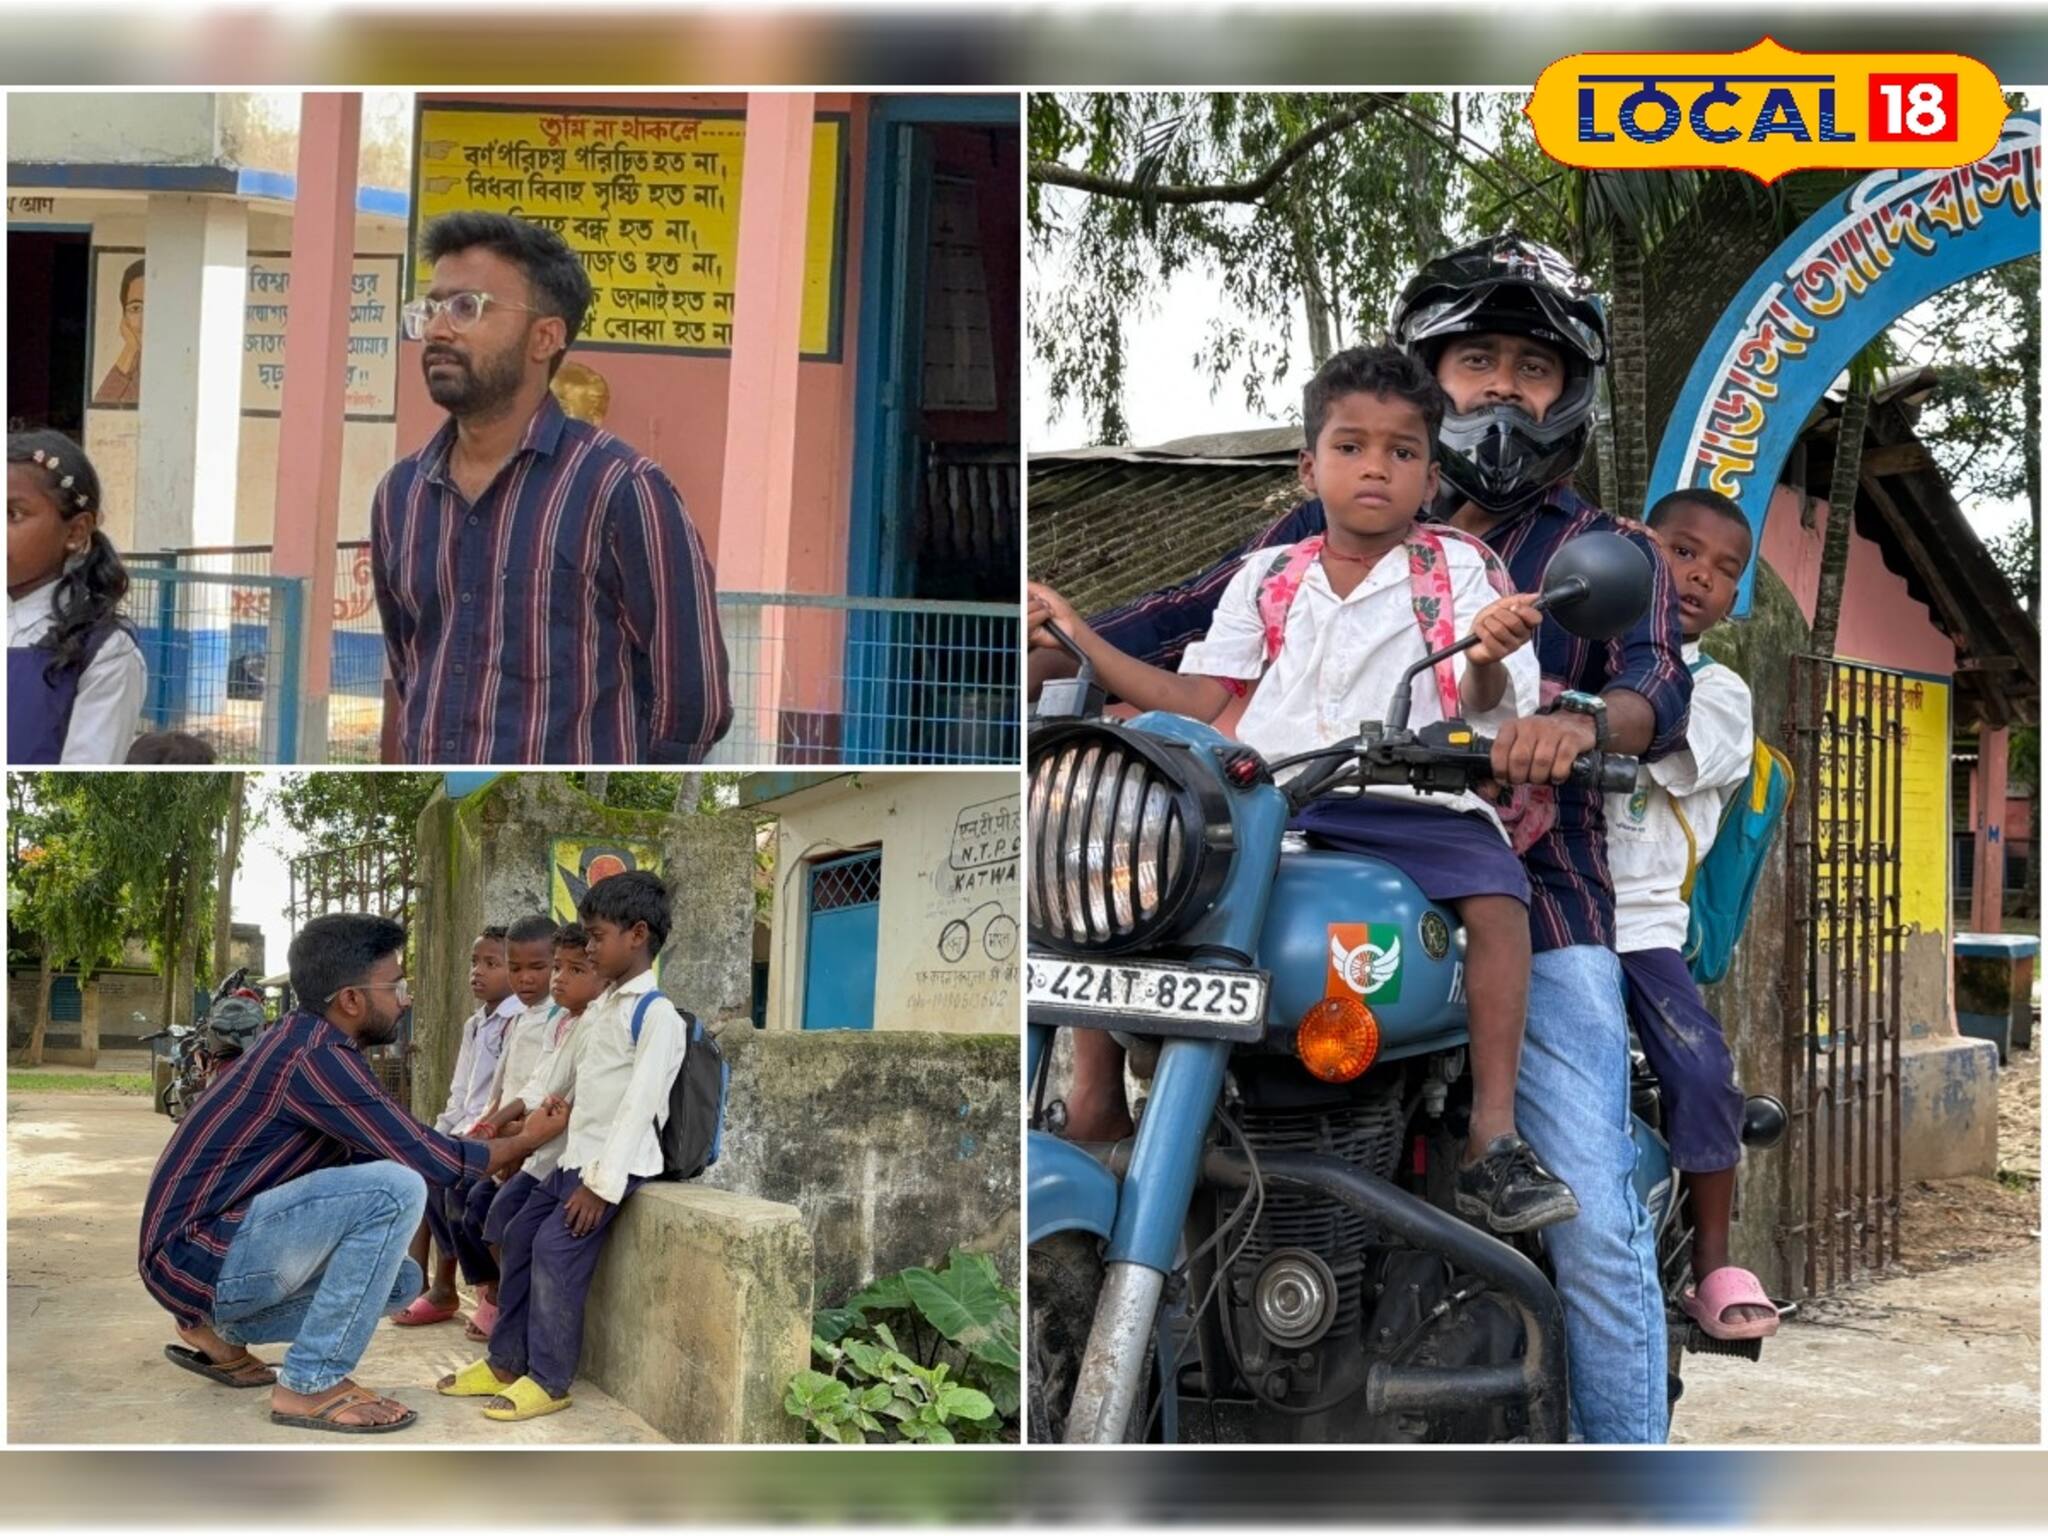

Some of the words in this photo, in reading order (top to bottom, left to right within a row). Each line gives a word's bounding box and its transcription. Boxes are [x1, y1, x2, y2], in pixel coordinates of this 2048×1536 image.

[539, 116, 589, 146] তুমি
[594, 119, 617, 141] না
[652, 150, 686, 175] হত
[466, 170, 523, 200] বিধবা
[528, 172, 587, 201] বিবাহ
[647, 182, 688, 209] হত
[572, 217, 610, 247] বন্ধ
[619, 218, 654, 247] হত
[646, 252, 681, 278] হত
[671, 291, 706, 316] হত
[604, 317, 666, 340] বোঝা
[672, 320, 706, 344] হত
[954, 863, 1016, 893] KATWA
[1051, 964, 1141, 1004] 42AT
[1158, 973, 1251, 1015] 8225
